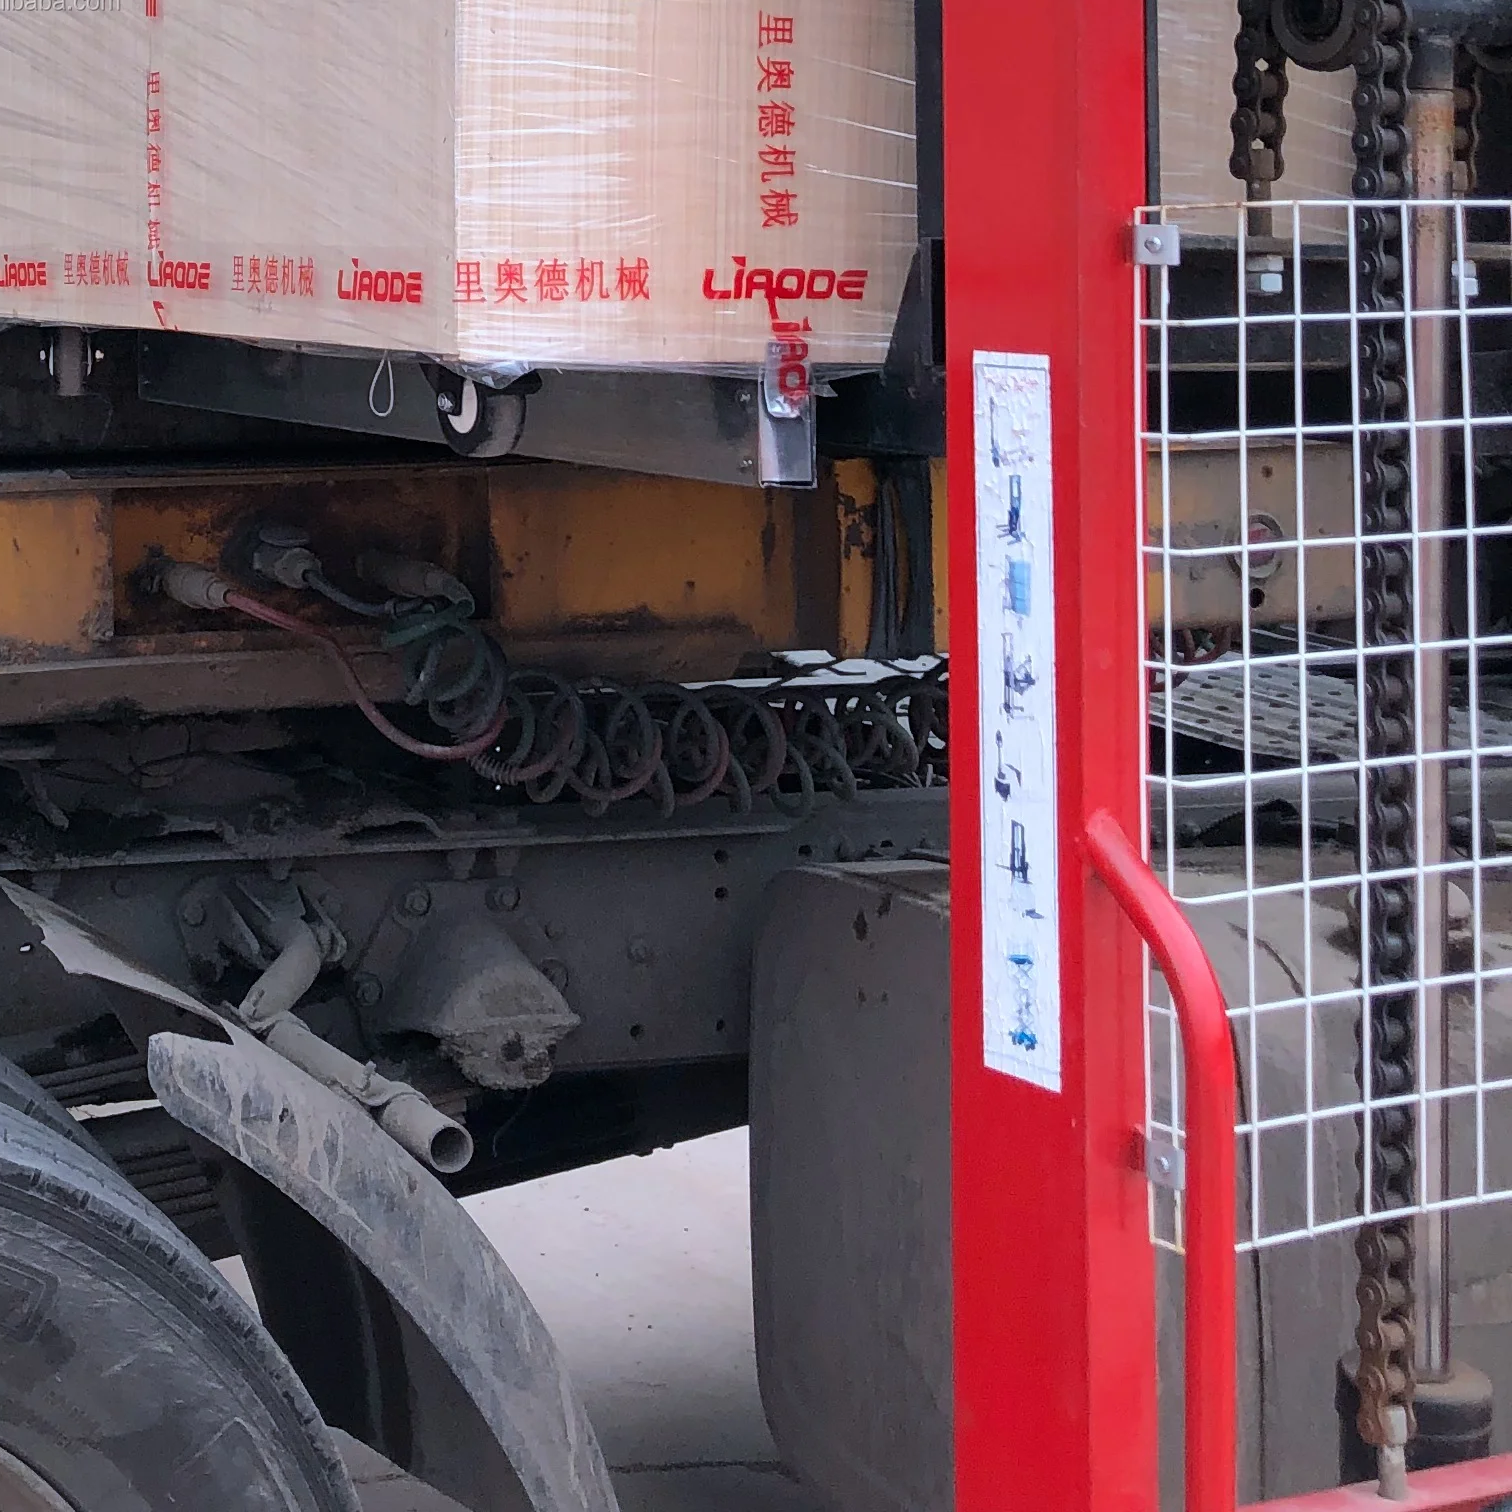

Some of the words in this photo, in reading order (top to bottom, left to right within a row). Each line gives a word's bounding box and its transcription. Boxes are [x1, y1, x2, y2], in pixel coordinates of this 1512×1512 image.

[756, 9, 799, 229] 里奥德机械
[64, 251, 129, 286] 里奥德机械
[231, 255, 314, 296] 里奥德机械
[452, 257, 651, 304] 里奥德机械
